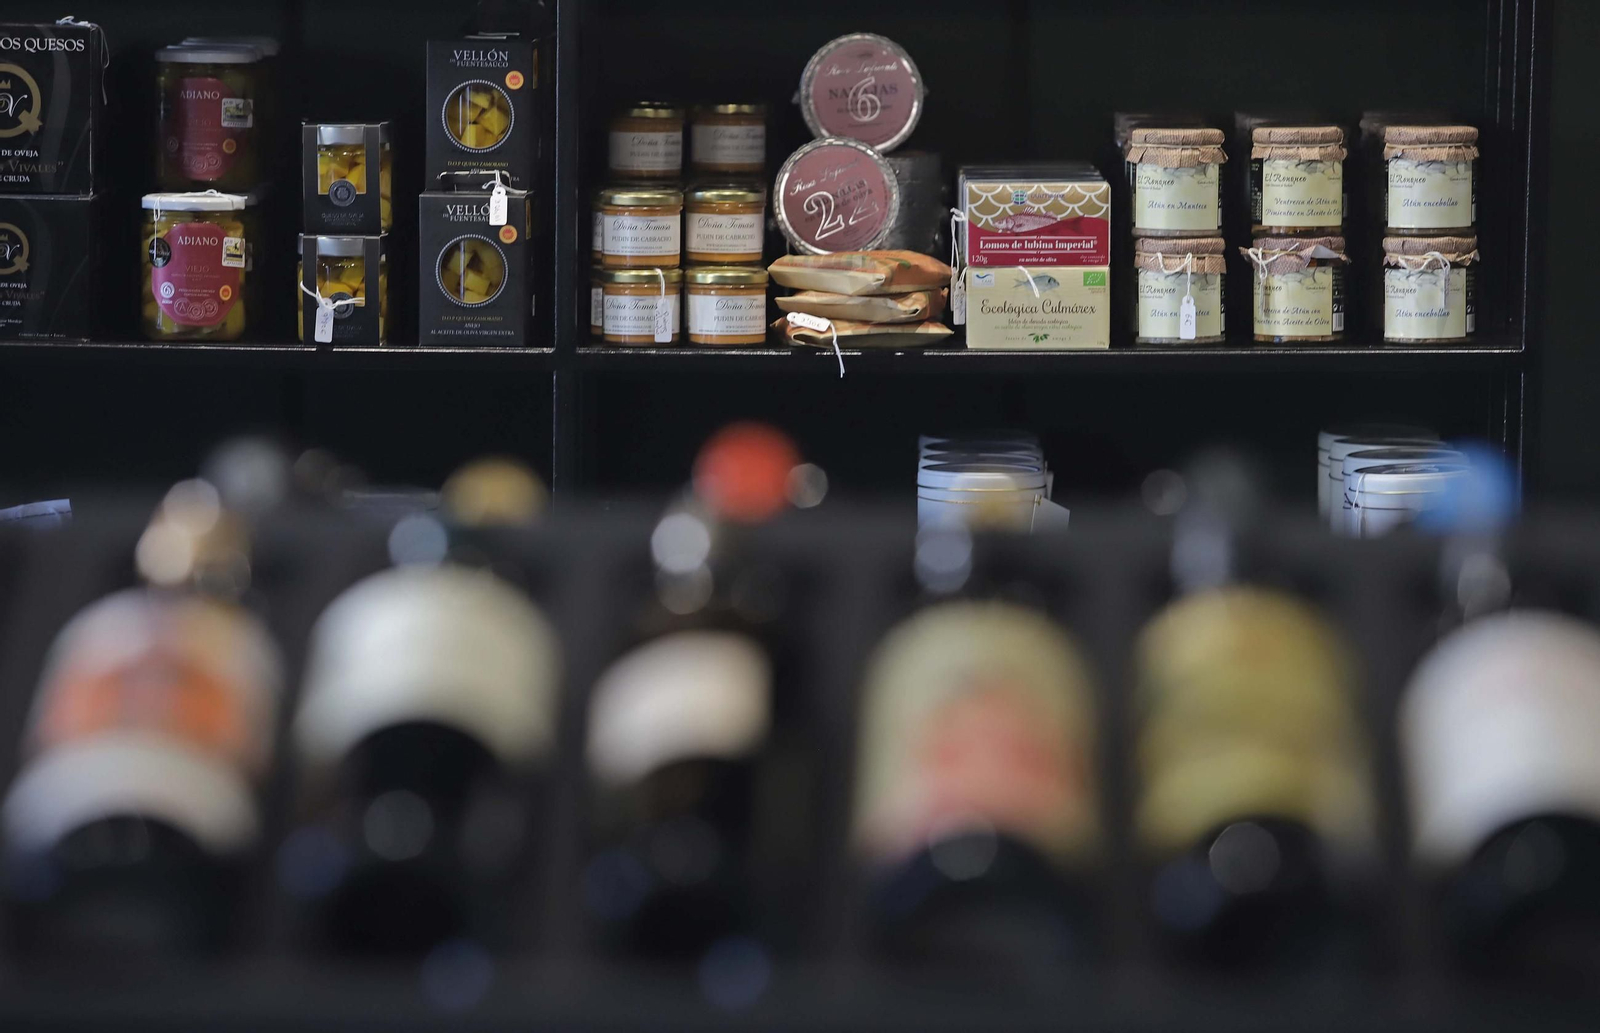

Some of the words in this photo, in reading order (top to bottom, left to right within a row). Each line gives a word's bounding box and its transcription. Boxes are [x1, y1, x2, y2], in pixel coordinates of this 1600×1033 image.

[24, 38, 85, 53] QUESOS
[453, 48, 509, 62] VELLÓN
[457, 61, 509, 69] FUENTESAUCO
[180, 90, 220, 100] ADIANO
[847, 76, 882, 123] 6
[1, 150, 12, 158] DE
[14, 150, 39, 158] OVEJA
[480, 160, 509, 168] ZAMORANO
[3, 175, 30, 183] CRUDA
[1144, 177, 1175, 188] Ronqueo
[1272, 174, 1307, 185] Ronqueo
[1396, 175, 1427, 188] Ronqueo
[1167, 200, 1175, 210] en
[1177, 200, 1207, 210] Manteca
[1274, 197, 1305, 206] Ventresca
[1306, 197, 1314, 206] de
[1402, 198, 1422, 208] Atún
[446, 202, 491, 216] VELLÓ
[1297, 208, 1305, 217] en
[1306, 208, 1326, 217] Aceite
[612, 216, 638, 231] Doña
[639, 219, 671, 231] Tomasa
[697, 217, 723, 229] Doña
[723, 217, 755, 229] Tomasa
[177, 236, 219, 246] ADIANO
[979, 240, 1010, 250] Lomos
[1011, 240, 1022, 250] de
[1024, 240, 1054, 250] lubina
[971, 254, 988, 264] 120g
[185, 264, 210, 274] VIEJO
[1146, 285, 1177, 298] Ronqueo
[1390, 284, 1417, 295] Ronqueo
[605, 298, 627, 311] Doña
[628, 299, 658, 311] Tomas
[715, 299, 743, 312] Doña
[980, 299, 1039, 318] Ecológica
[1041, 299, 1097, 315] Culmárex
[1282, 305, 1289, 314] de
[1290, 305, 1310, 314] Atún
[1150, 309, 1168, 318] Atún
[1170, 309, 1178, 318] en
[1395, 308, 1412, 318] Atún
[1273, 317, 1281, 326] en
[1281, 317, 1304, 326] Aceite
[1305, 317, 1313, 326] de
[1313, 317, 1330, 326] Oliva
